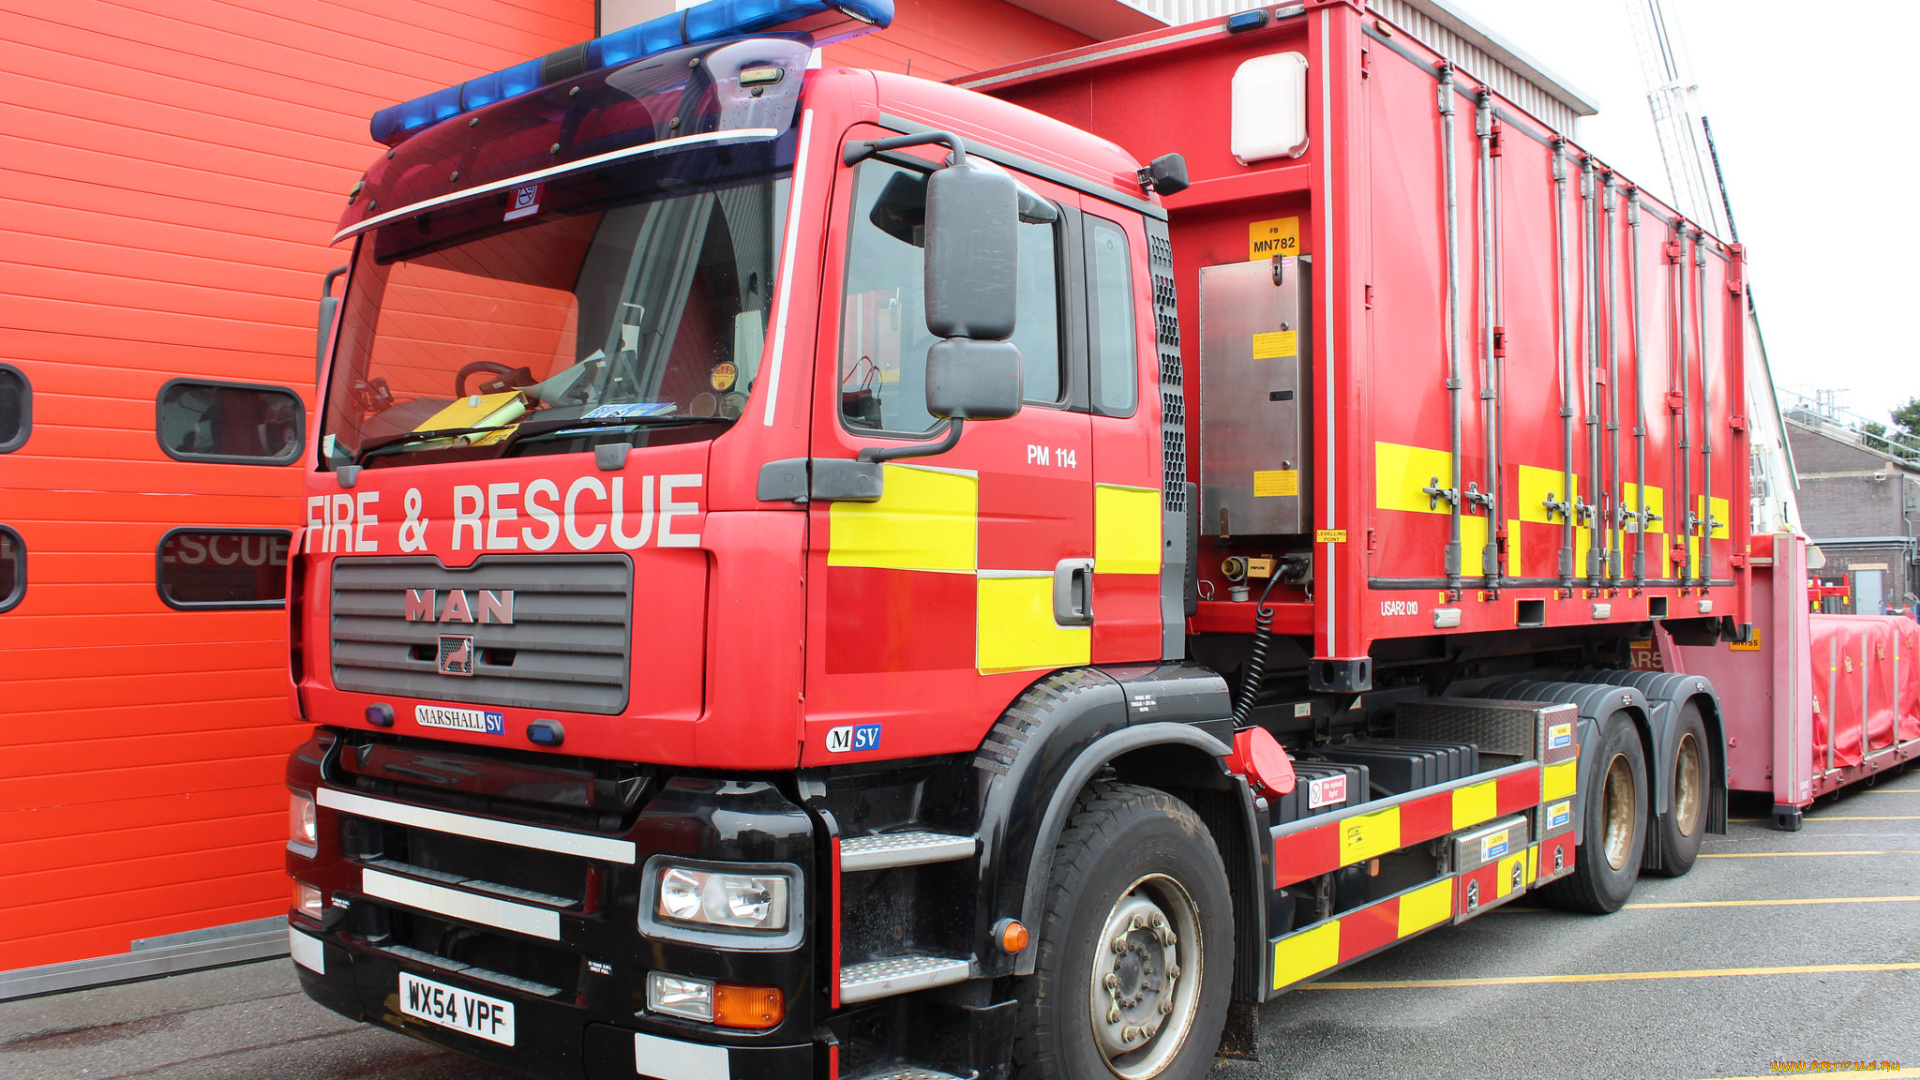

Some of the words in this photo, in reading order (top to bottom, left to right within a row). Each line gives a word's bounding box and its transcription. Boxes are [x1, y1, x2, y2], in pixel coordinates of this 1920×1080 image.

[1254, 237, 1296, 253] MN782
[1027, 444, 1050, 466] PM
[1055, 447, 1077, 469] 114
[305, 491, 380, 554] FIRE
[398, 487, 429, 552] &
[451, 473, 703, 551] RESCUE
[405, 589, 514, 625] MAN
[1380, 601, 1406, 616] USAR2
[1406, 600, 1418, 615] 010
[418, 708, 484, 729] MARSHALL
[486, 714, 502, 731] SV
[831, 729, 852, 748] M
[855, 727, 880, 748] SV
[409, 980, 457, 1023] WX54
[464, 996, 506, 1035] VPF
